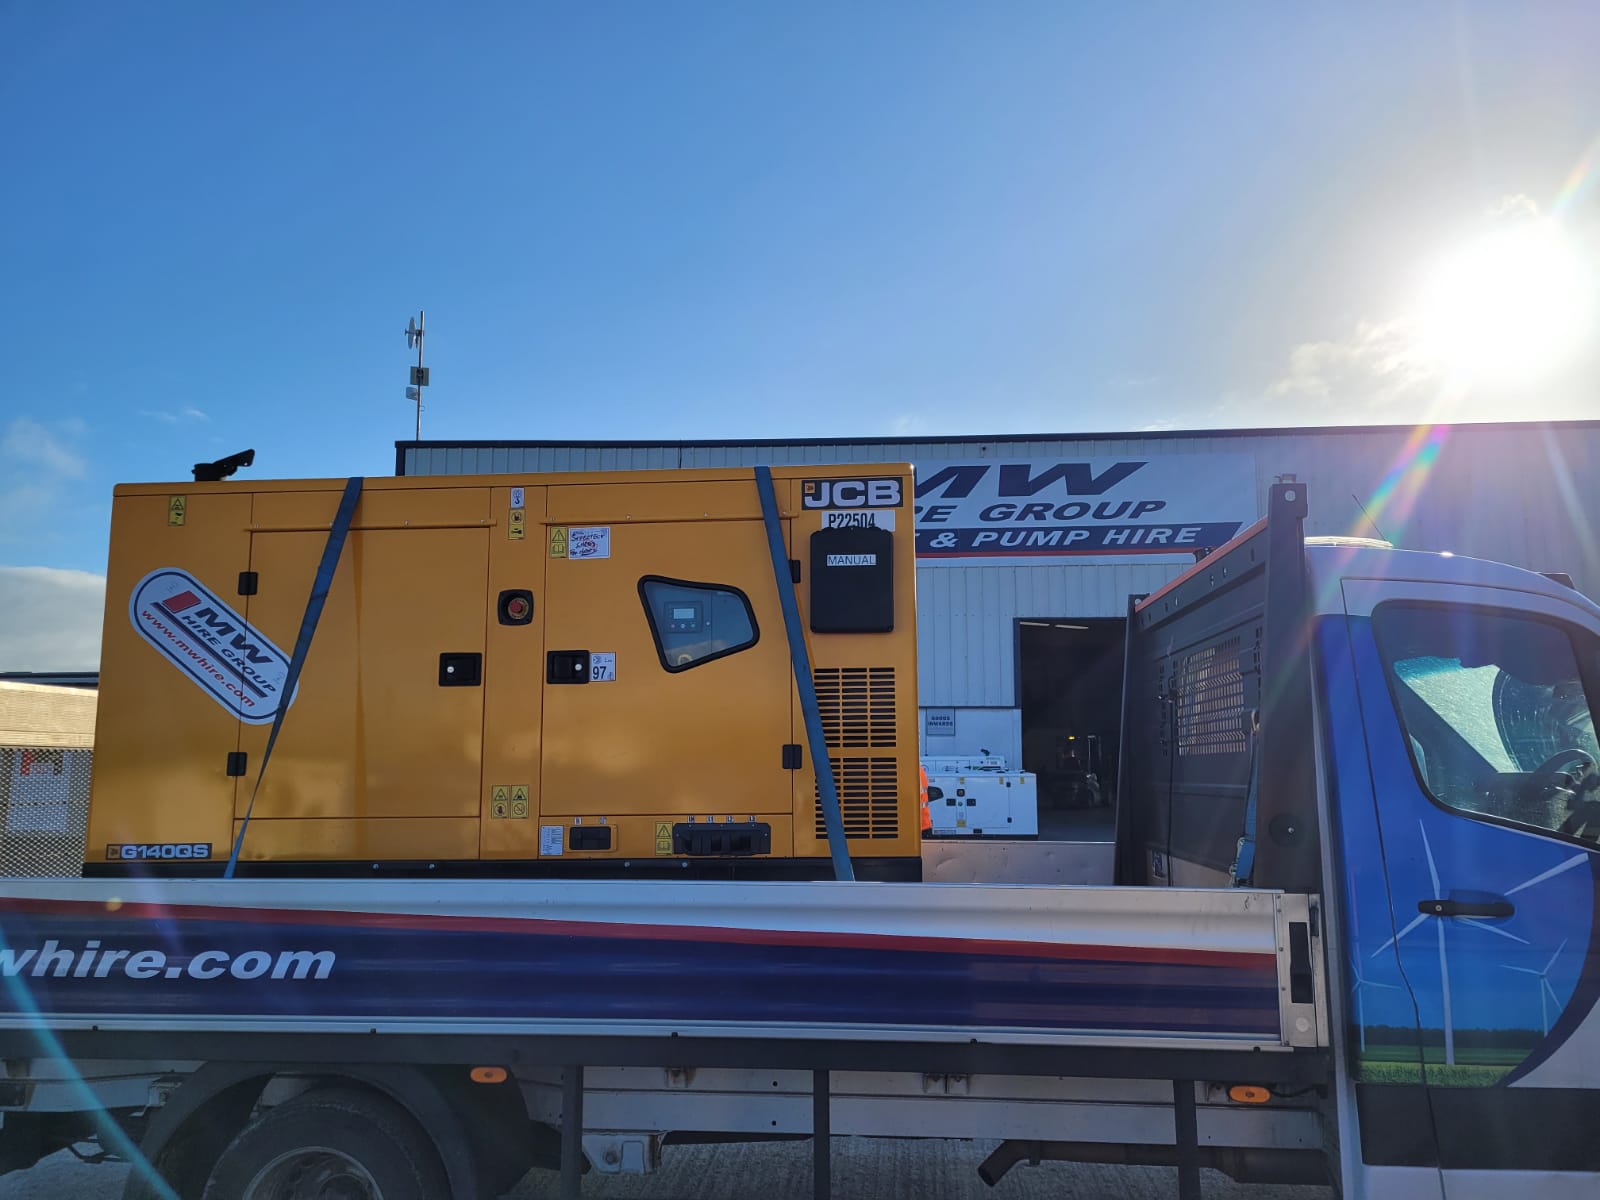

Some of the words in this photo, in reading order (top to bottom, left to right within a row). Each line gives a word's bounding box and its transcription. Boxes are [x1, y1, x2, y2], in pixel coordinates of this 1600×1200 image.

[804, 480, 901, 508] JCB
[828, 512, 876, 529] P22504
[979, 500, 1167, 522] GROUP
[929, 532, 959, 549] &
[971, 529, 1091, 547] PUMP
[1102, 526, 1202, 545] HIRE
[827, 554, 876, 566] MANUAL
[194, 606, 274, 665] MW
[141, 609, 256, 708] www.mwhire.com
[181, 615, 222, 647] HIRE
[221, 648, 277, 693] GROUP
[592, 665, 607, 680] 97
[121, 844, 209, 859] G140QS
